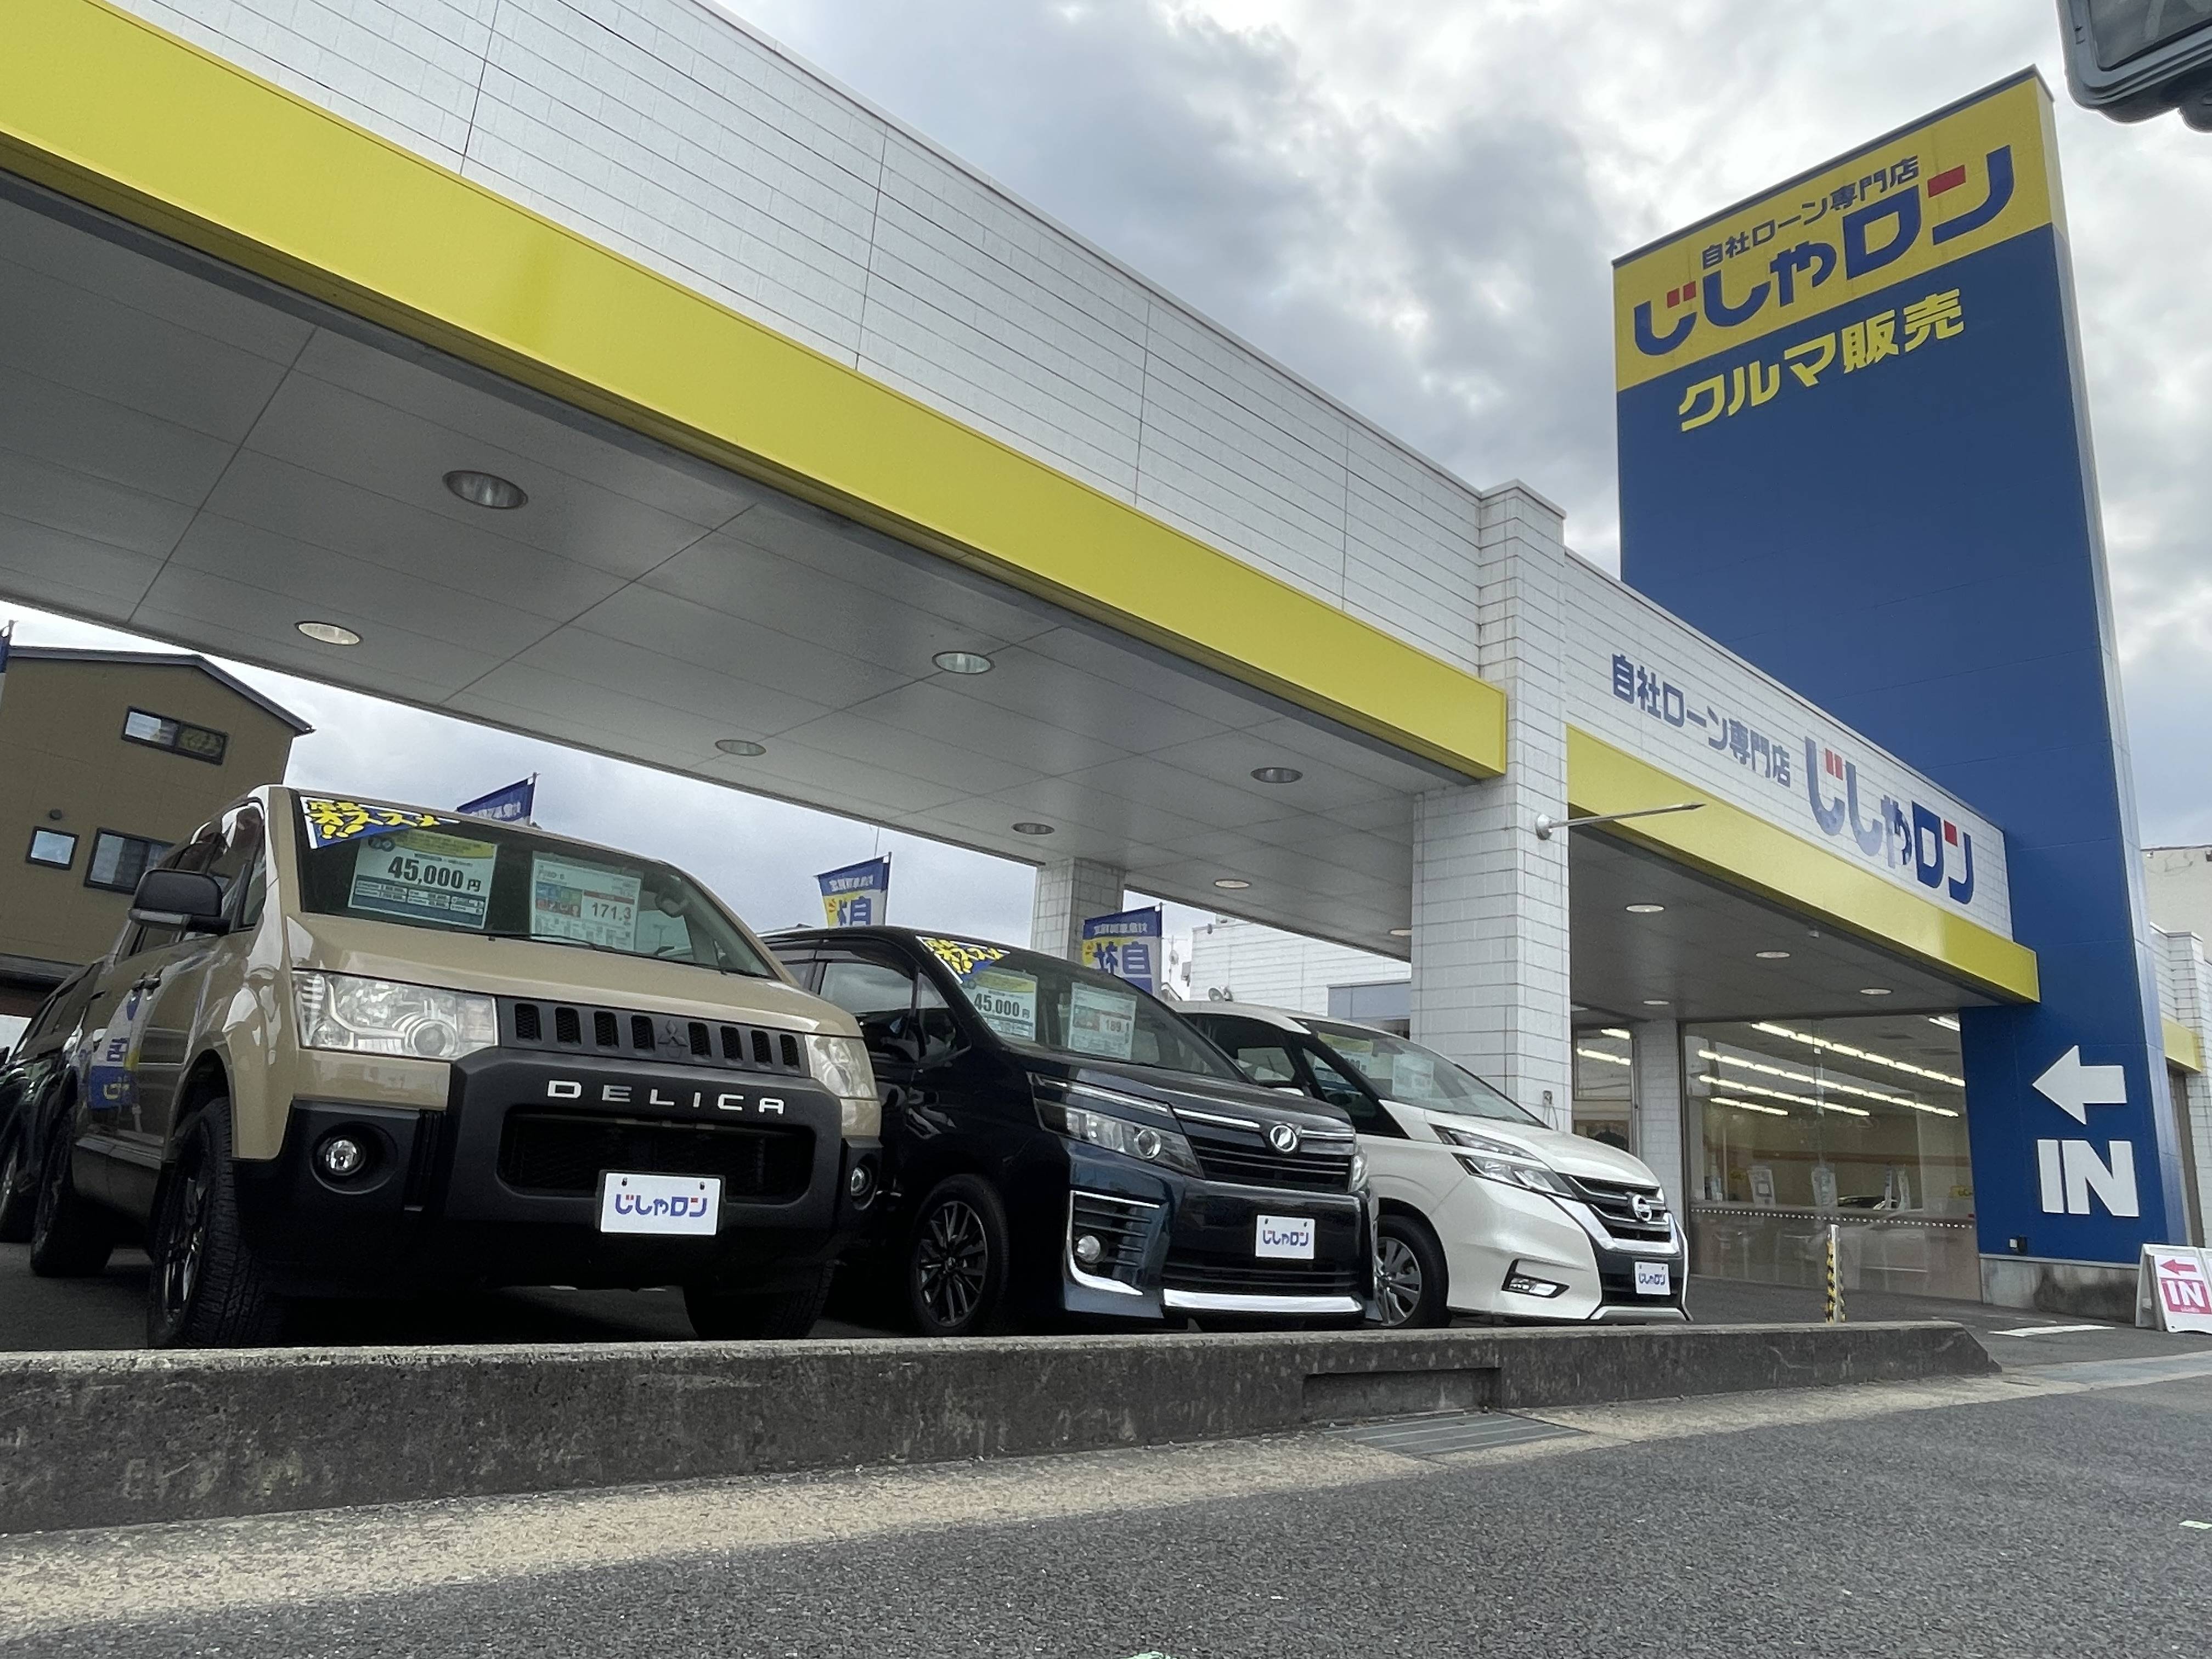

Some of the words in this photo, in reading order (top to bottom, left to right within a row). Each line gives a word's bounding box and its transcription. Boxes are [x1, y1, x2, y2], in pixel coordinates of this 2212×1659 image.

[1634, 145, 2014, 357] じしゃロン
[1702, 156, 1918, 269] 自社ローン専門店
[1679, 289, 1964, 432] クルマ販売
[1612, 653, 1790, 788] 自社ローン専門店
[1805, 736, 1973, 905] じしゃロン
[388, 856, 463, 889] 45,000
[467, 879, 481, 893] 円
[591, 903, 631, 921] 171.3
[547, 1080, 785, 1114] DELICA
[616, 1193, 708, 1218] じしゃロン
[2038, 1139, 2140, 1217] IN
[2167, 1280, 2206, 1308] IN
